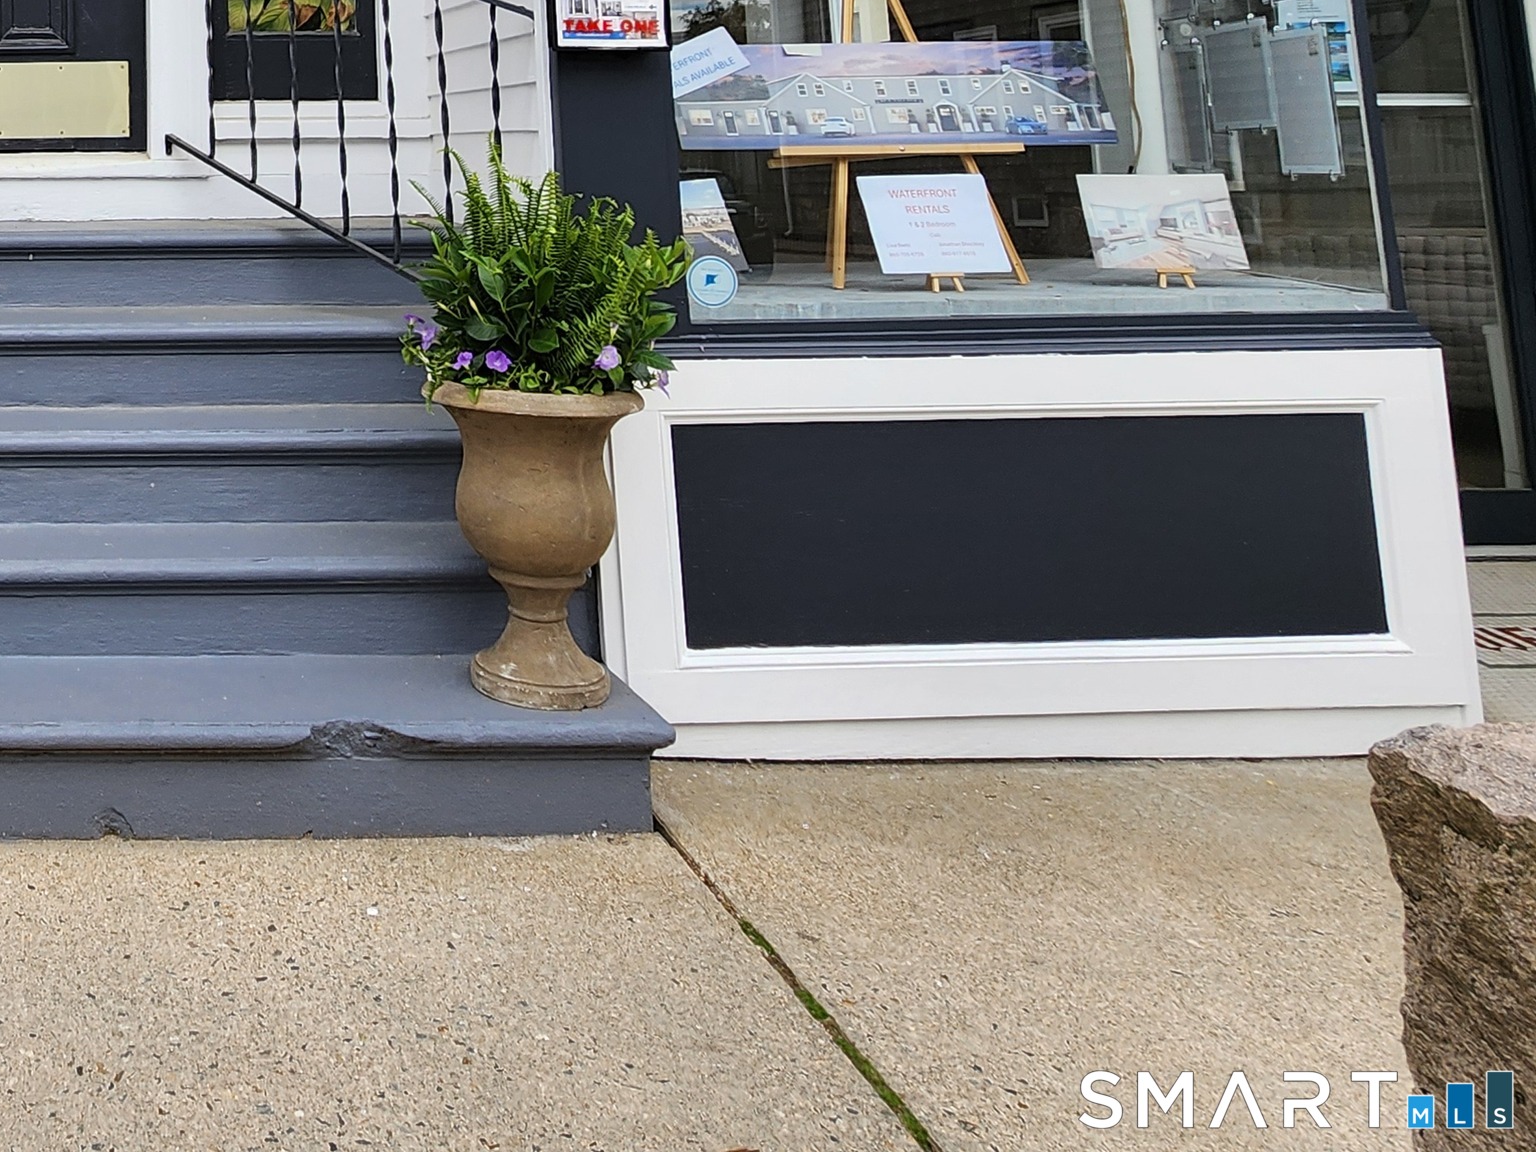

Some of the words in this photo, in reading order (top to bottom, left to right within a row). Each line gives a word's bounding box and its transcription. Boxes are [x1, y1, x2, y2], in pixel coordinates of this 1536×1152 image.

[563, 18, 613, 34] TAKE
[620, 18, 660, 35] ONE
[690, 56, 736, 82] AVAILABLE
[887, 188, 957, 199] WATERFRONT
[904, 204, 951, 215] RENTALS
